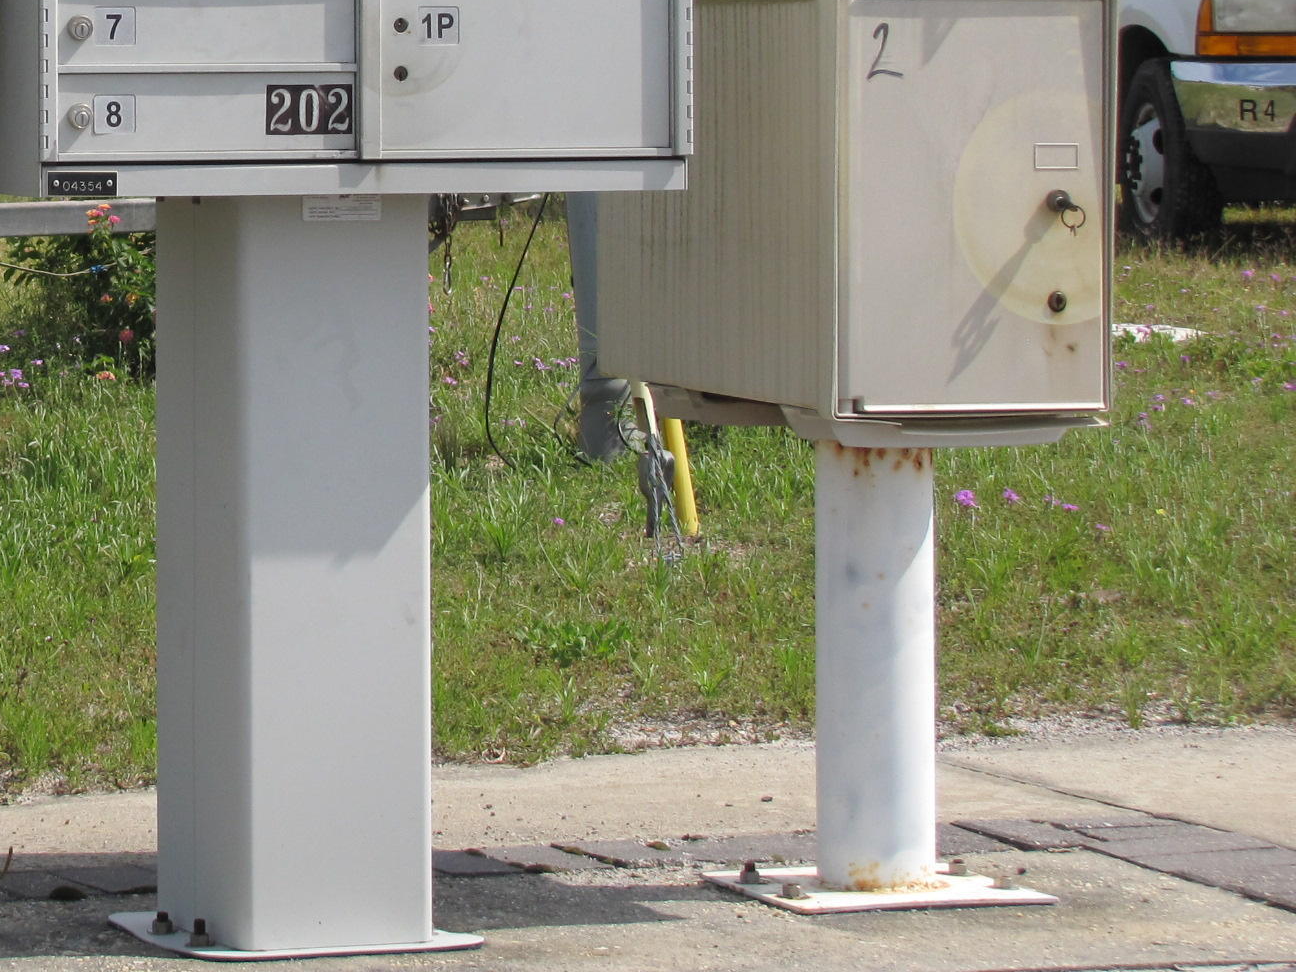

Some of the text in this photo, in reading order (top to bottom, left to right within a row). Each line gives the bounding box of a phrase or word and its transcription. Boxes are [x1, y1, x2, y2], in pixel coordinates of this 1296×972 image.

[105, 14, 123, 39] 7
[421, 14, 454, 39] 1P
[866, 22, 903, 80] 2
[105, 102, 123, 127] 8
[269, 87, 350, 132] 202
[62, 180, 102, 192] 04354
